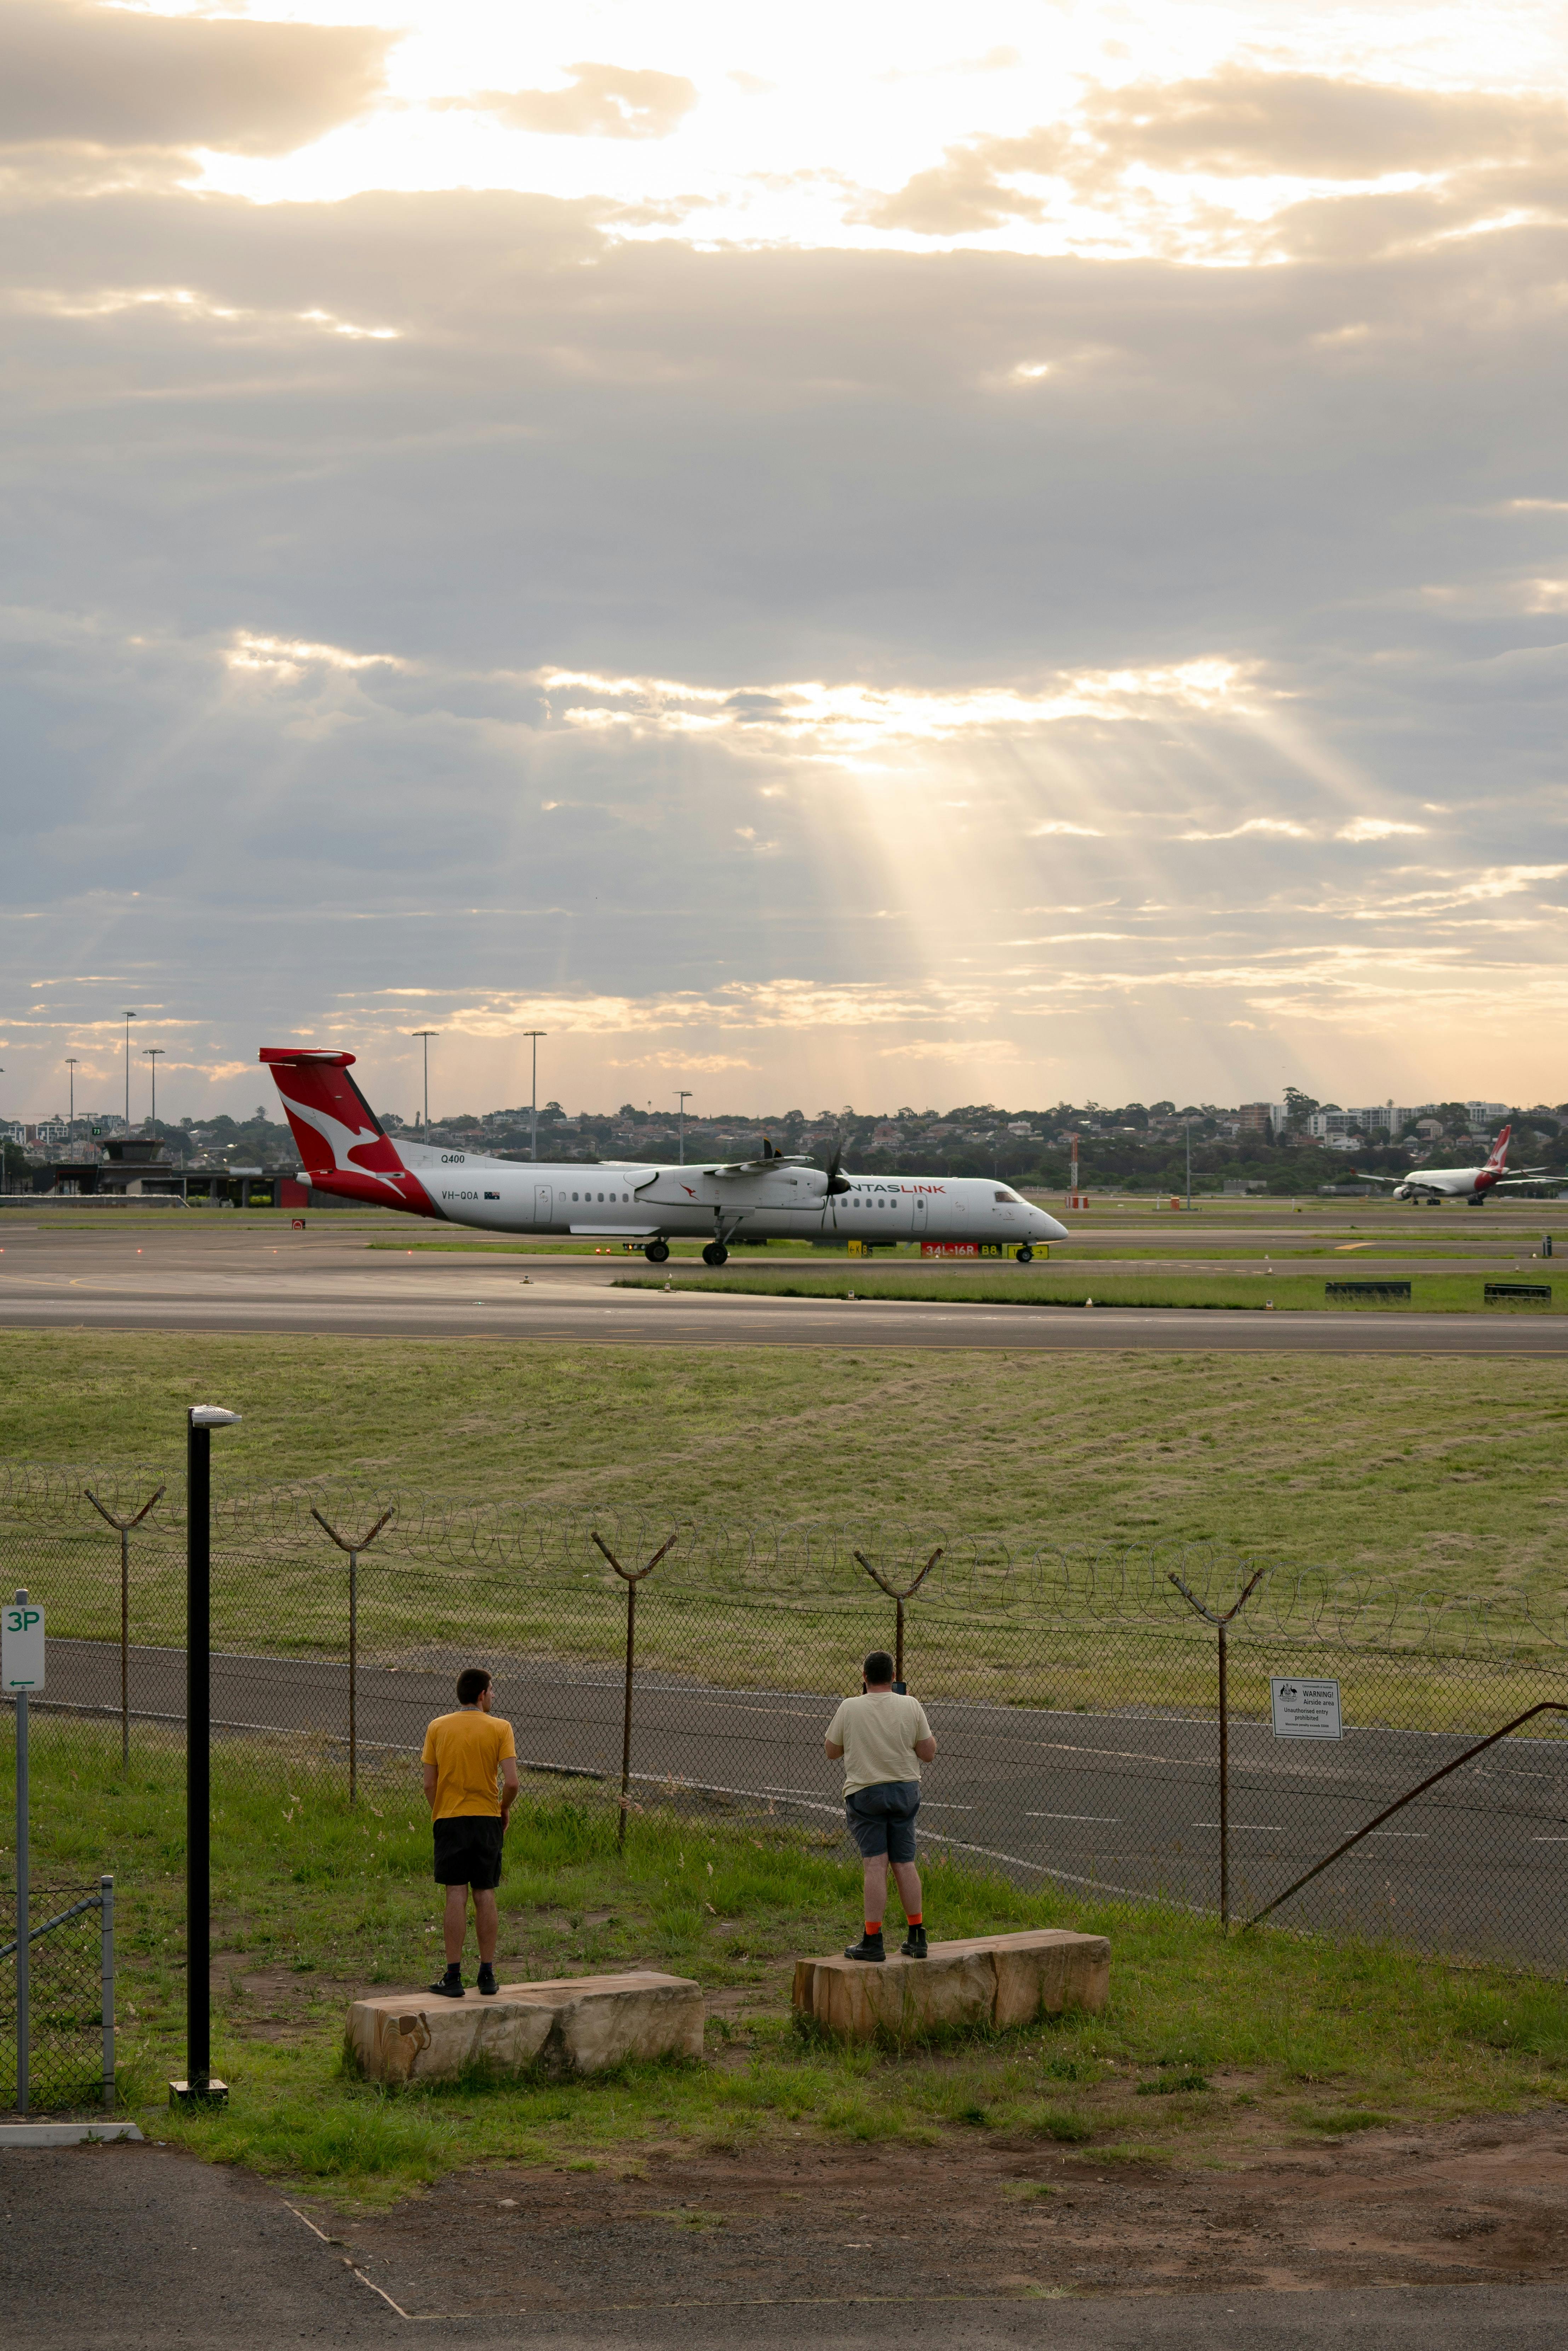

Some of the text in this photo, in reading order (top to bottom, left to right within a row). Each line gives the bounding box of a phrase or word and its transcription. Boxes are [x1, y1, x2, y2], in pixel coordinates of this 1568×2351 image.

[441, 1155, 464, 1163] Q400
[849, 1184, 946, 1194] NTASLINK
[442, 1191, 478, 1200] VH-QOA
[856, 1245, 859, 1254] K
[926, 1245, 997, 1255] 34L-16R B8
[7, 1611, 40, 1632] 3P
